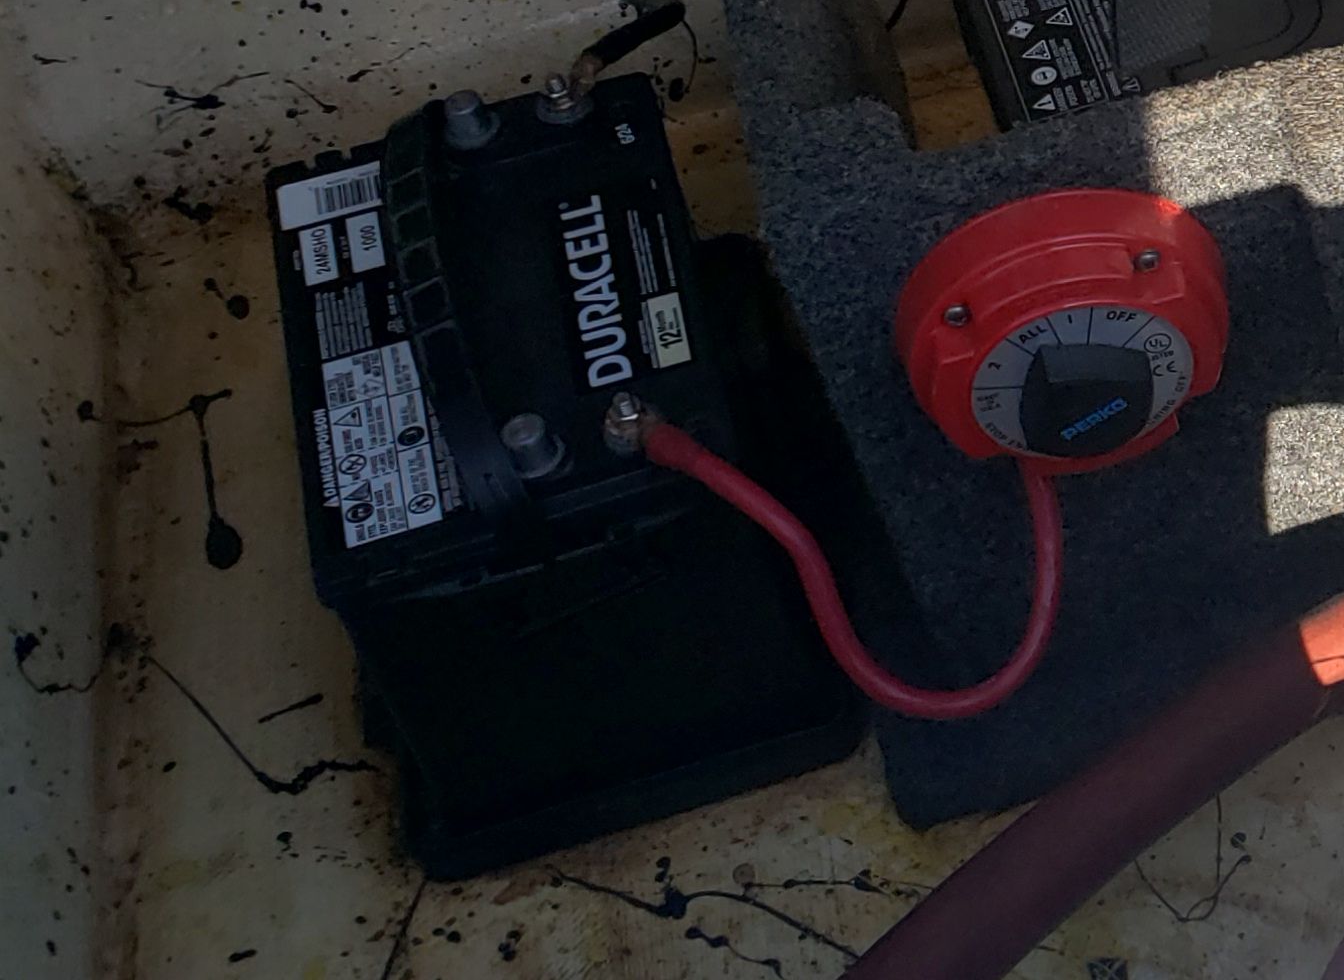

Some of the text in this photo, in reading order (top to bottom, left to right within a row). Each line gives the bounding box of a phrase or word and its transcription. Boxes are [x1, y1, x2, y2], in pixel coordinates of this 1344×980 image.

[360, 225, 377, 251] 1000
[560, 194, 633, 388] DURACELL
[1106, 310, 1138, 322] OFF
[658, 328, 684, 350] 12
[1018, 325, 1049, 345] ALL
[987, 361, 1001, 371] 2
[1060, 397, 1128, 441] PERKO
